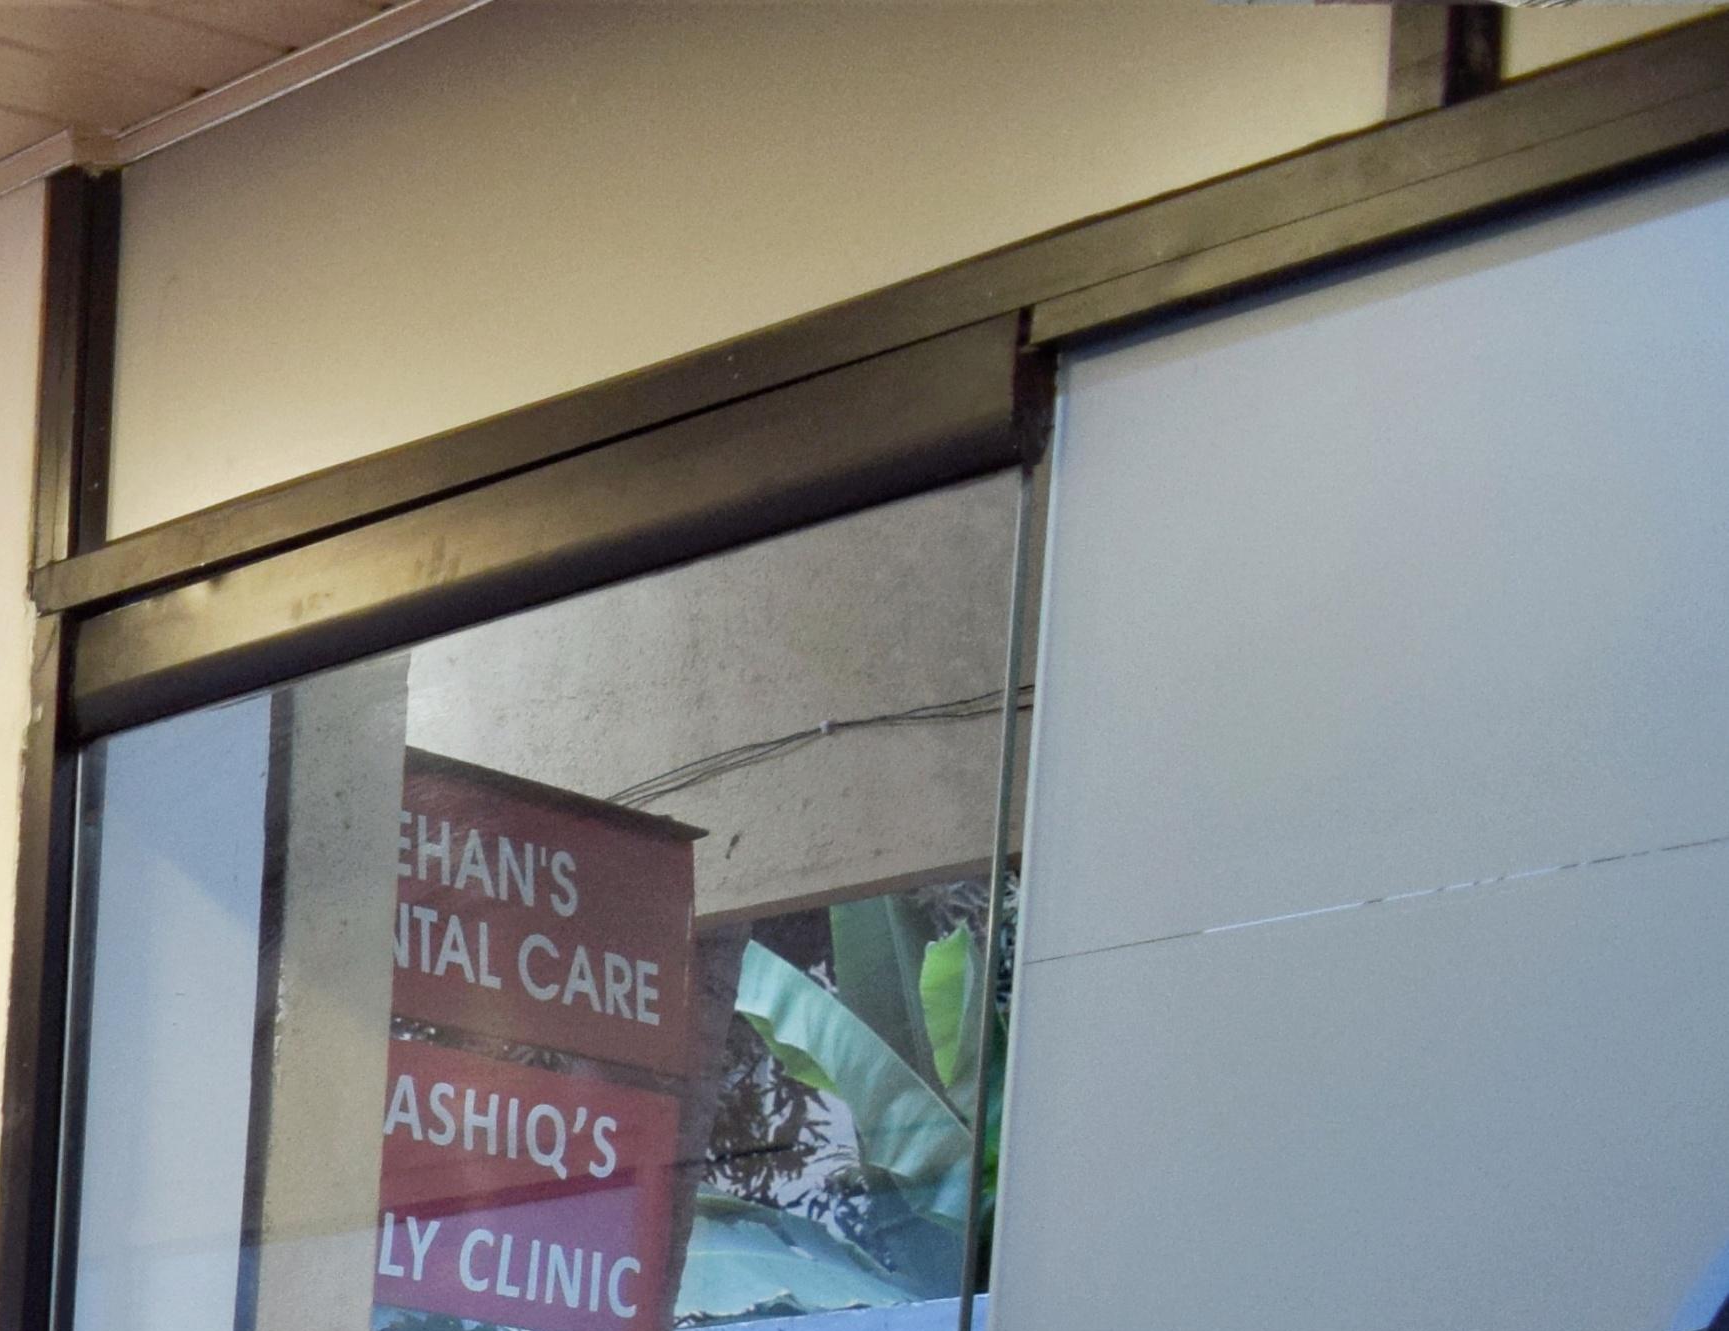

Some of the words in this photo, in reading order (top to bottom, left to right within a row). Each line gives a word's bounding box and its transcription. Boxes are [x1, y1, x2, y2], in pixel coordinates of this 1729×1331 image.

[517, 933, 661, 1028] CARE
[383, 1074, 619, 1181] ASHIQ'S
[377, 1211, 441, 1281] LY
[459, 1228, 642, 1320] CLINIC
